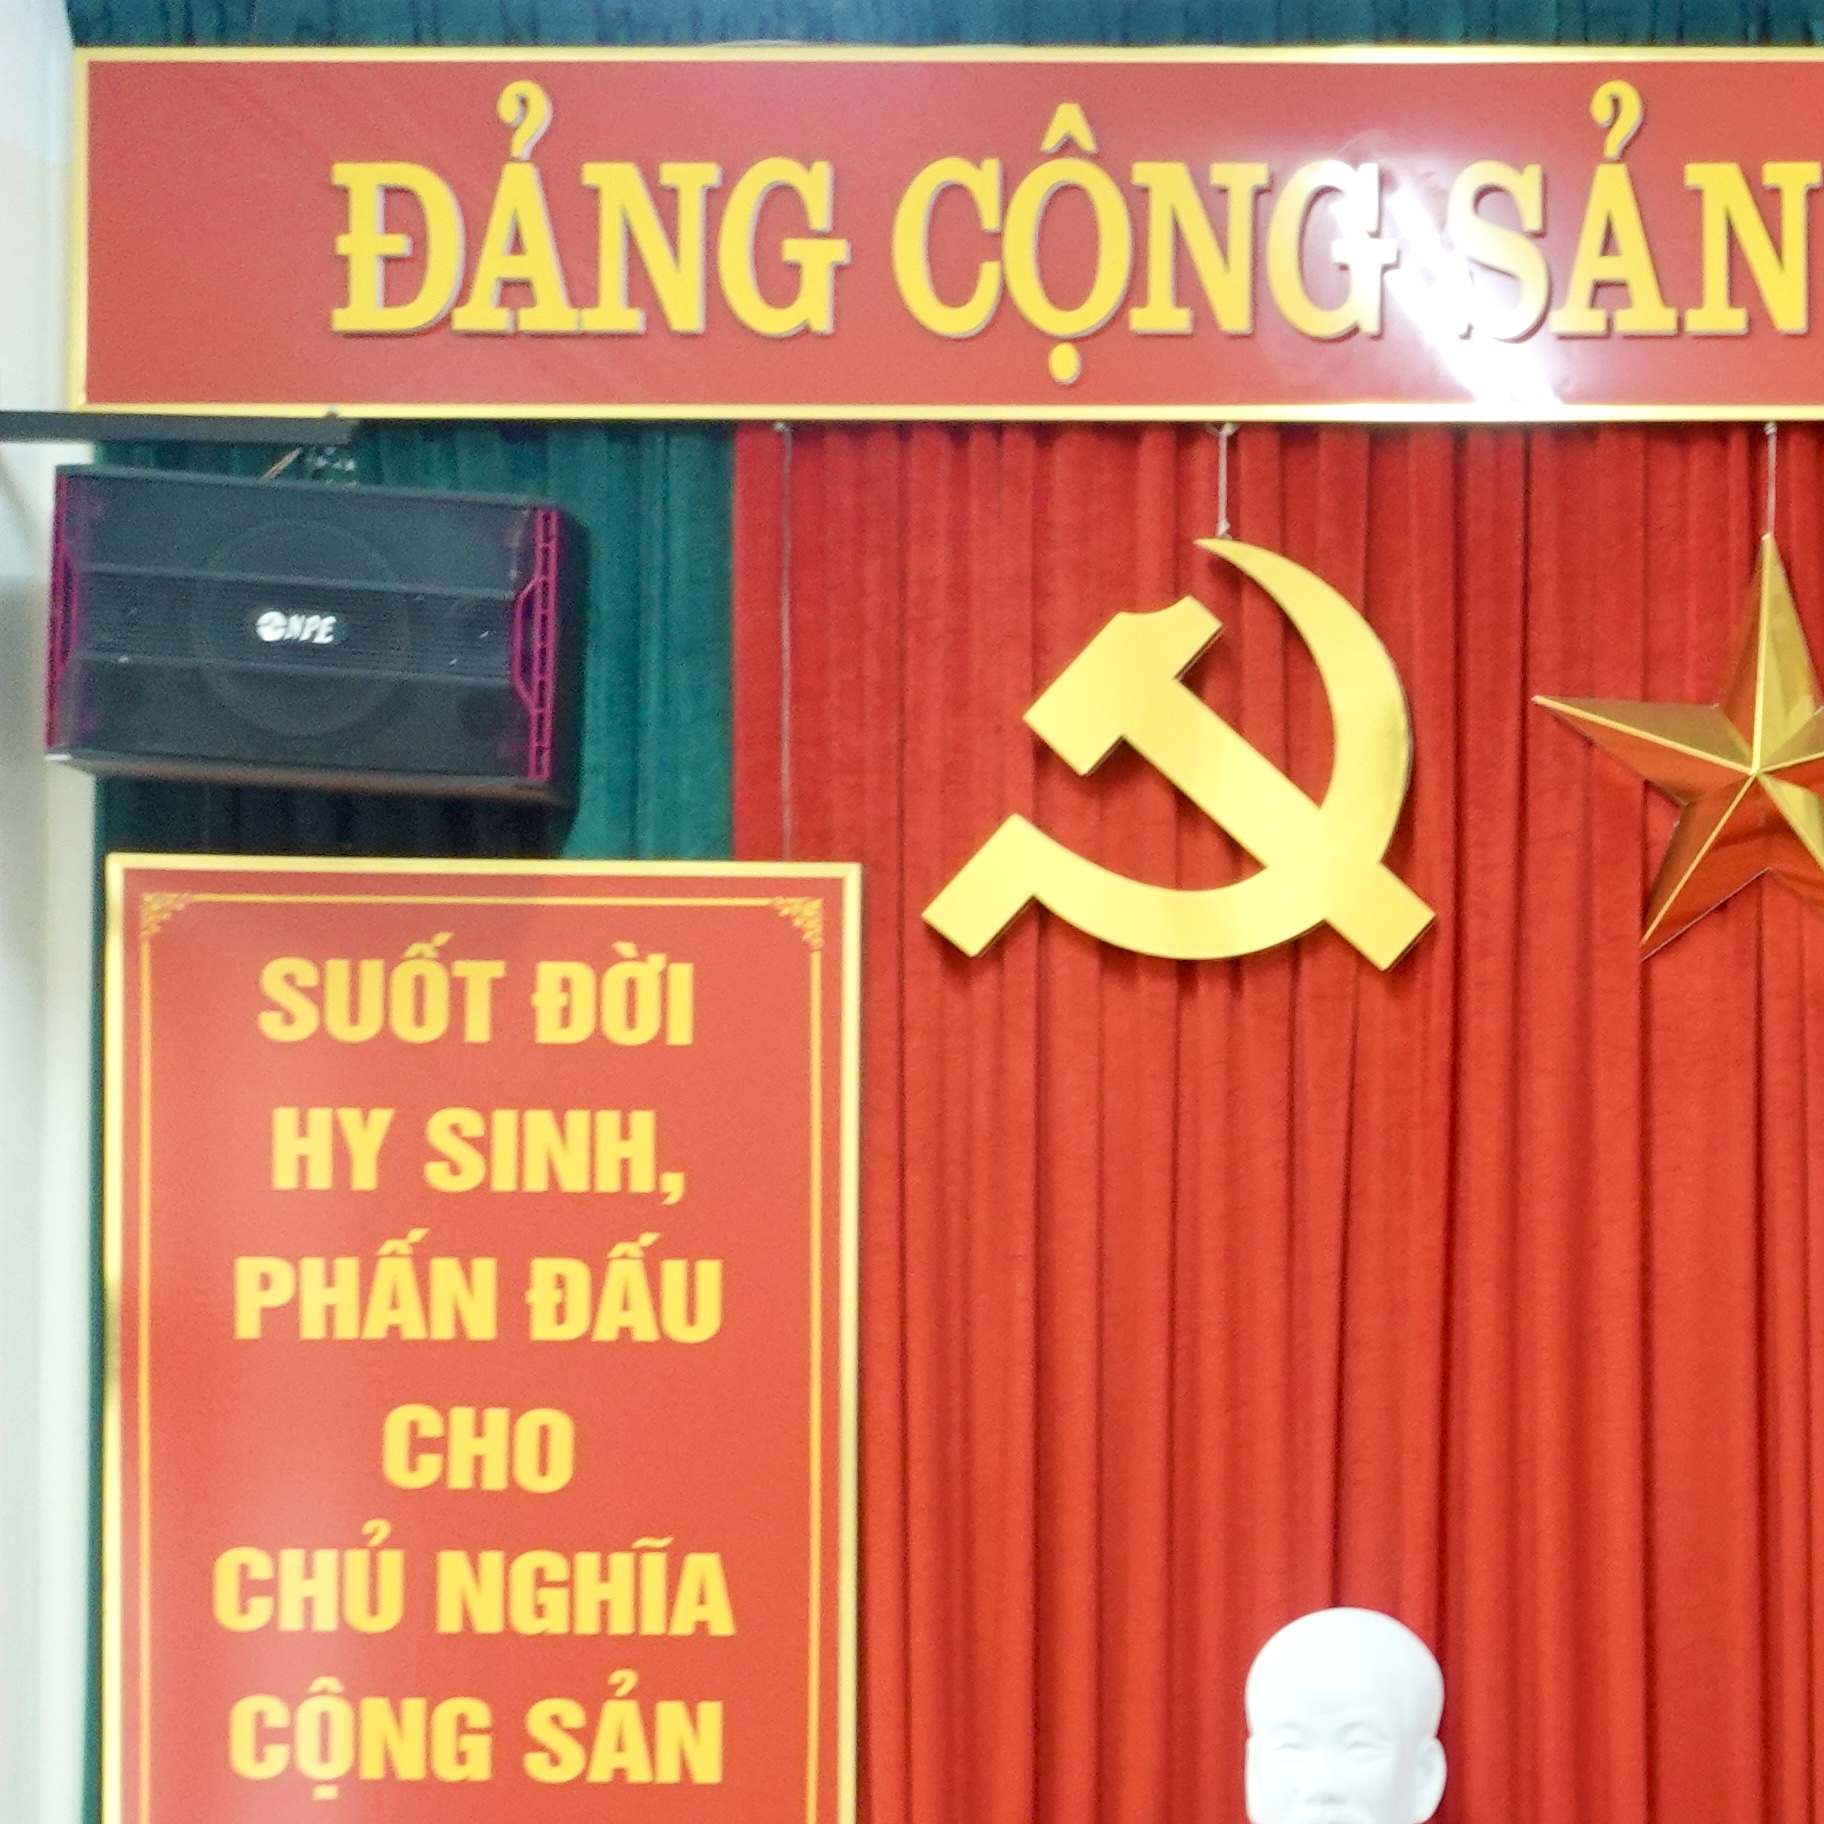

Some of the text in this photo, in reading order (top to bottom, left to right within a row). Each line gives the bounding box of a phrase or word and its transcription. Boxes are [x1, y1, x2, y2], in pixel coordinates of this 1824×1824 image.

[331, 79, 851, 338] ĐẢNG
[891, 102, 1398, 385] CỘNG
[1444, 79, 1824, 342] SẢN
[257, 932, 694, 1047] SUỐT ĐỜI
[270, 1106, 685, 1205] HY SINH,
[233, 1227, 722, 1344] PHẤN ĐẤU
[382, 1403, 575, 1494] CHO
[213, 1518, 736, 1636] CHỦ NGHĨA
[228, 1669, 723, 1802] CỘNG SẢN
